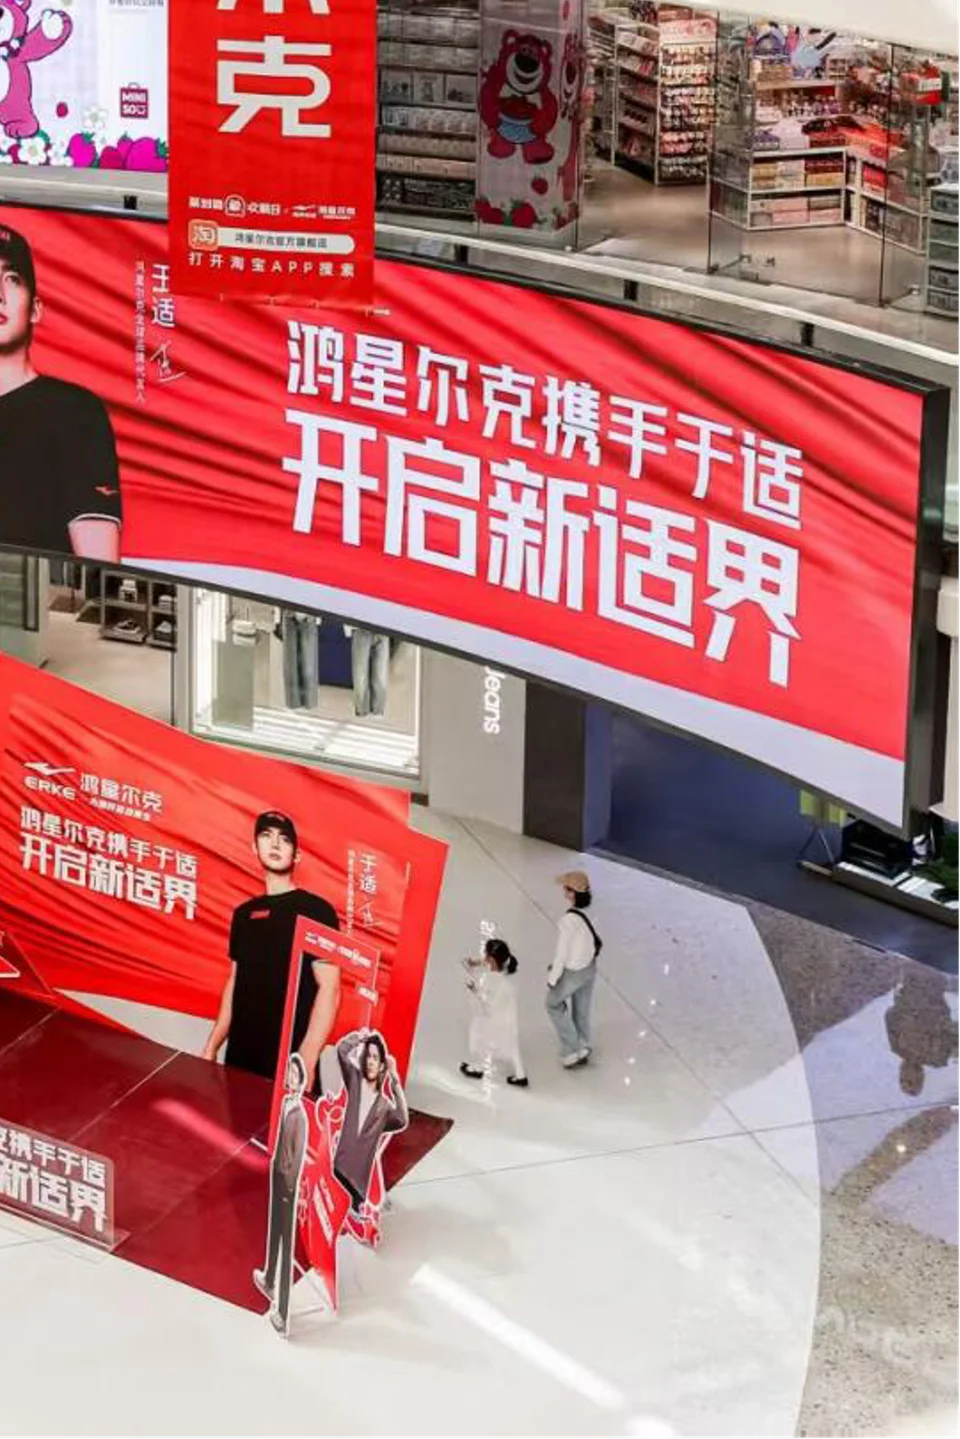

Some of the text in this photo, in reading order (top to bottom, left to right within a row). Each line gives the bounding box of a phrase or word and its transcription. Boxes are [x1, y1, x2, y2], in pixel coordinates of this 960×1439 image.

[286, 319, 804, 531] 鸿星尔克携手于适
[281, 408, 803, 690] 开启新适界
[24, 775, 76, 801] ERKE
[80, 772, 162, 813] 鸿星尔克
[21, 805, 198, 878] 鸿星尔克携手于适
